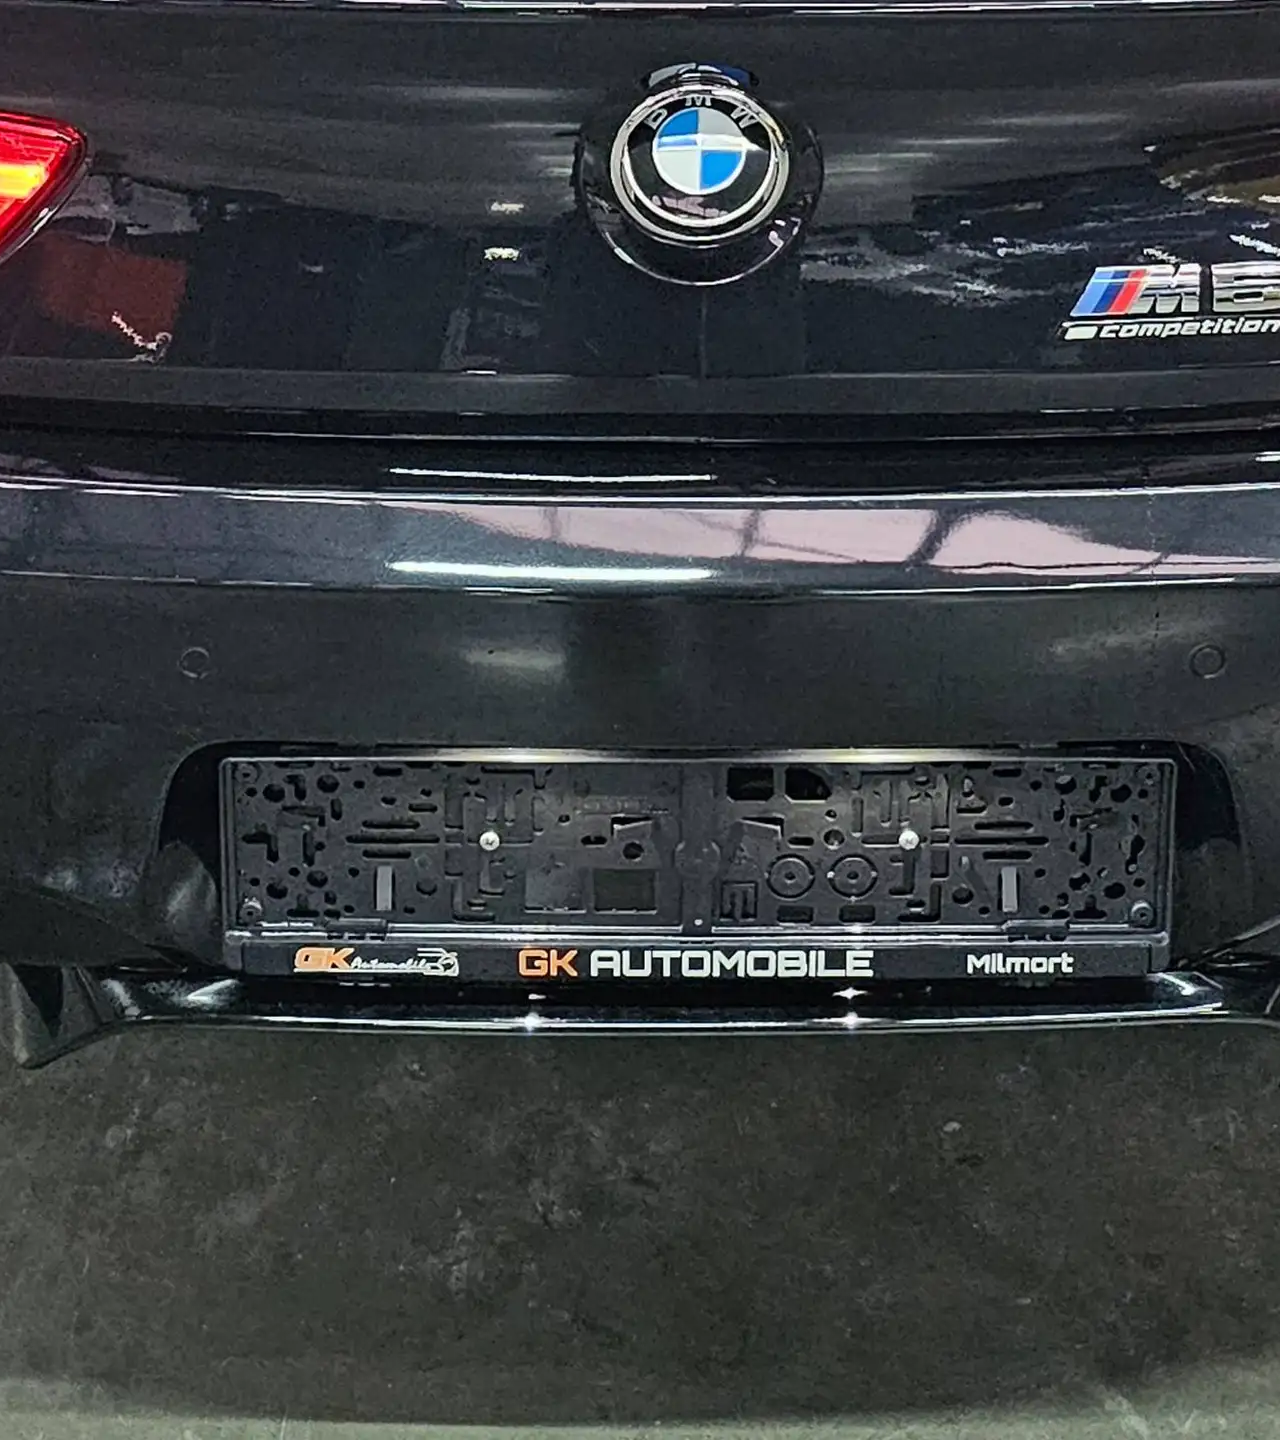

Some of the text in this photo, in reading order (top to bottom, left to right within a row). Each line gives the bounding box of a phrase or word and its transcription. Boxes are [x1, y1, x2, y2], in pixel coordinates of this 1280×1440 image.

[644, 95, 758, 130] BMW
[518, 949, 874, 978] GK AUTOMOBILE
[966, 952, 1075, 974] Milmort
